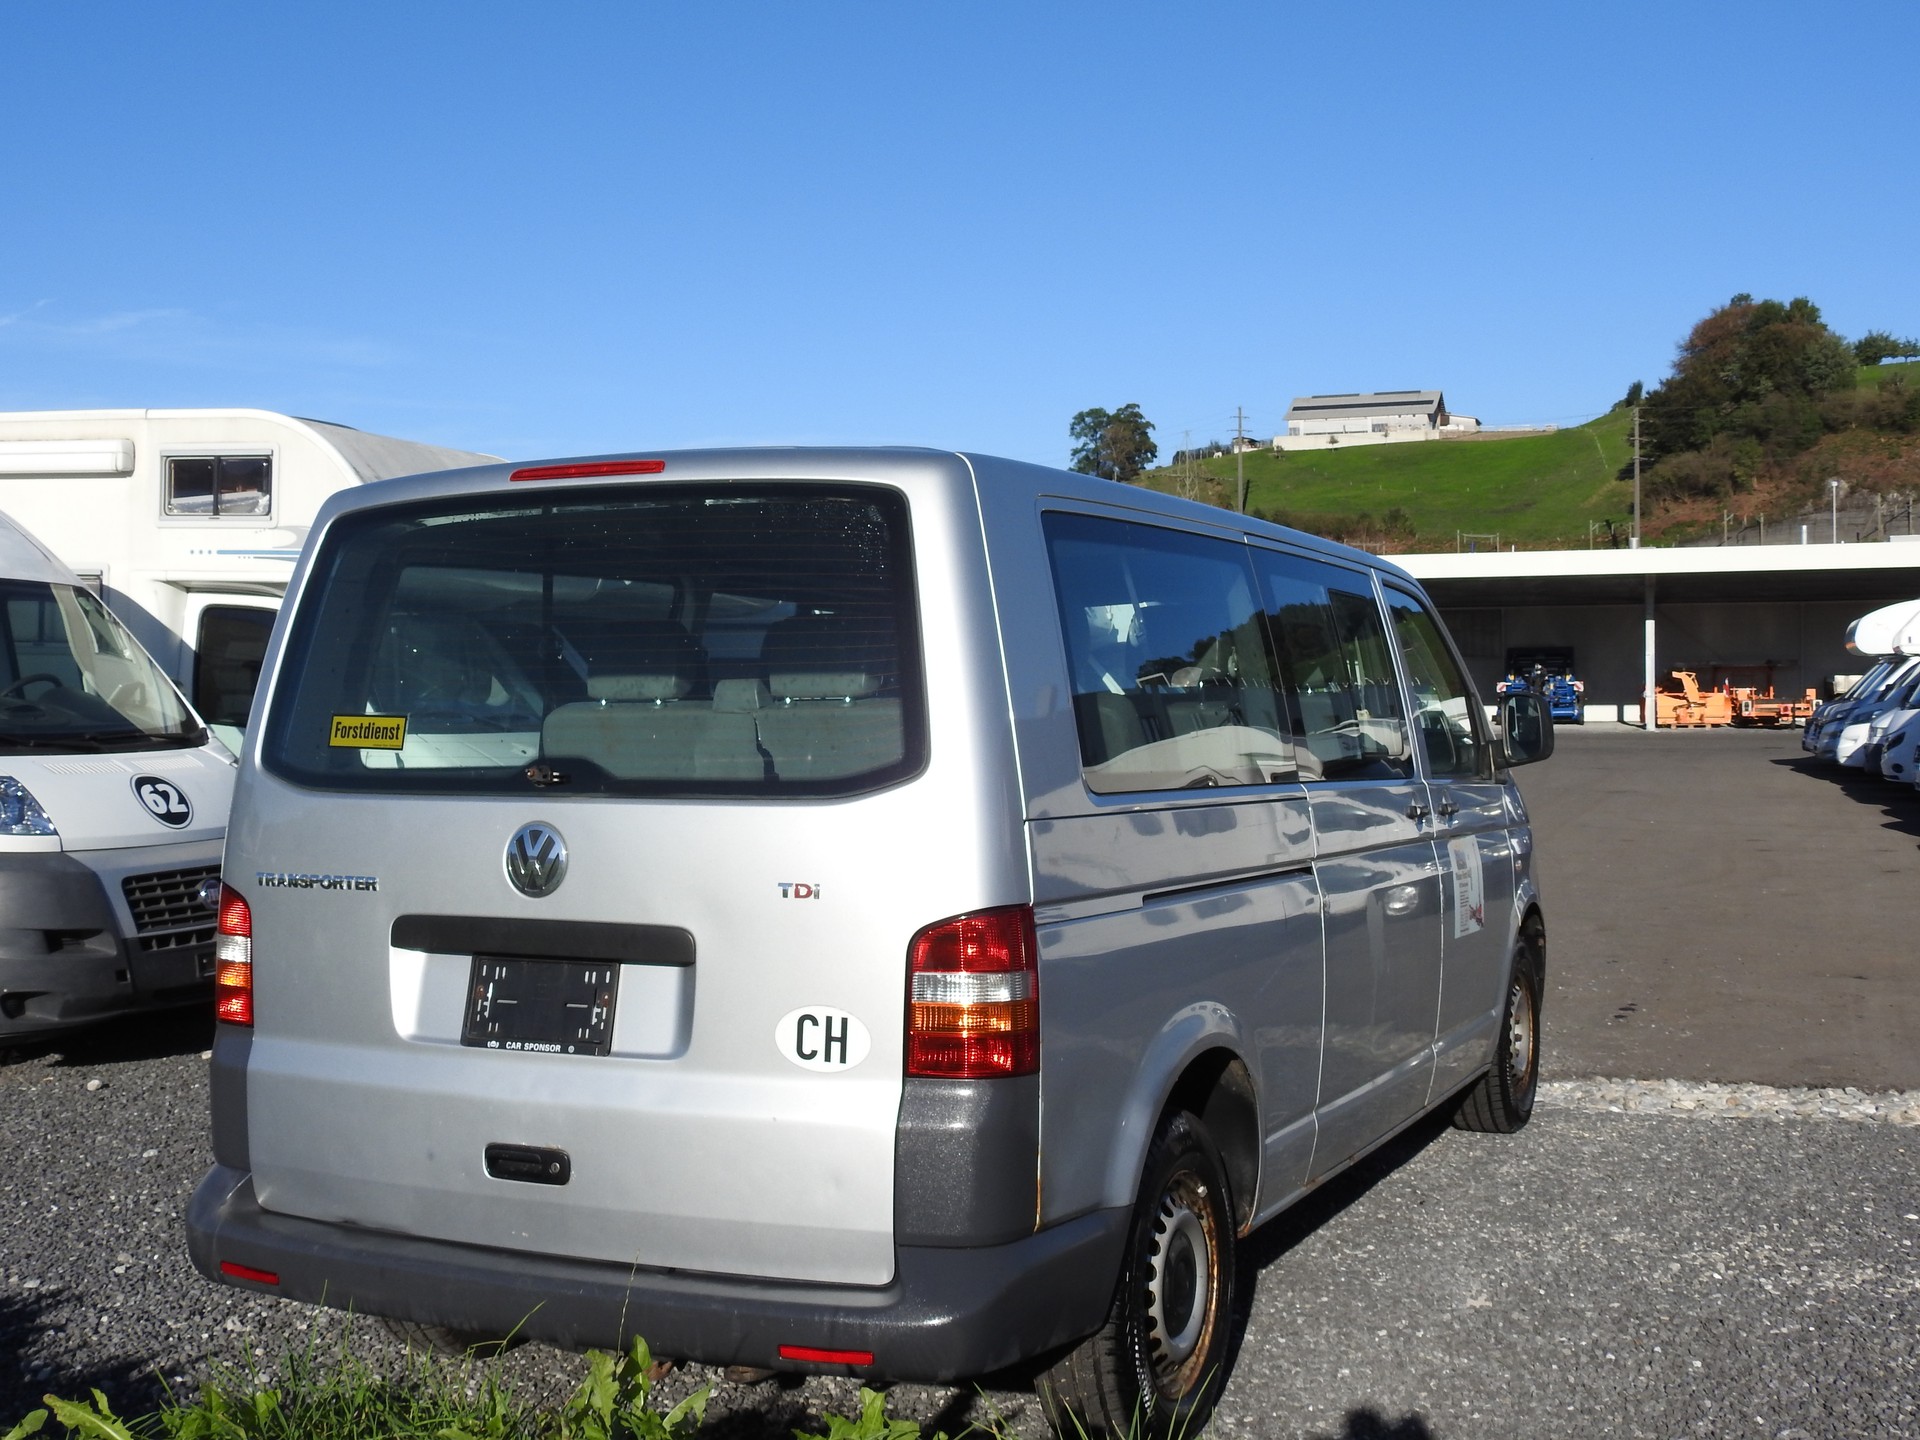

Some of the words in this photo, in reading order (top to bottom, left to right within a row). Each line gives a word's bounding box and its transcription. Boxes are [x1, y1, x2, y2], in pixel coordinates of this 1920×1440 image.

[334, 721, 401, 740] Forstdienst
[140, 783, 188, 815] 62
[509, 826, 564, 895] VW
[256, 872, 379, 892] TRANSPORTER
[505, 1041, 522, 1050] CAR
[523, 1042, 561, 1053] SPONSOR
[795, 1013, 848, 1065] CH
